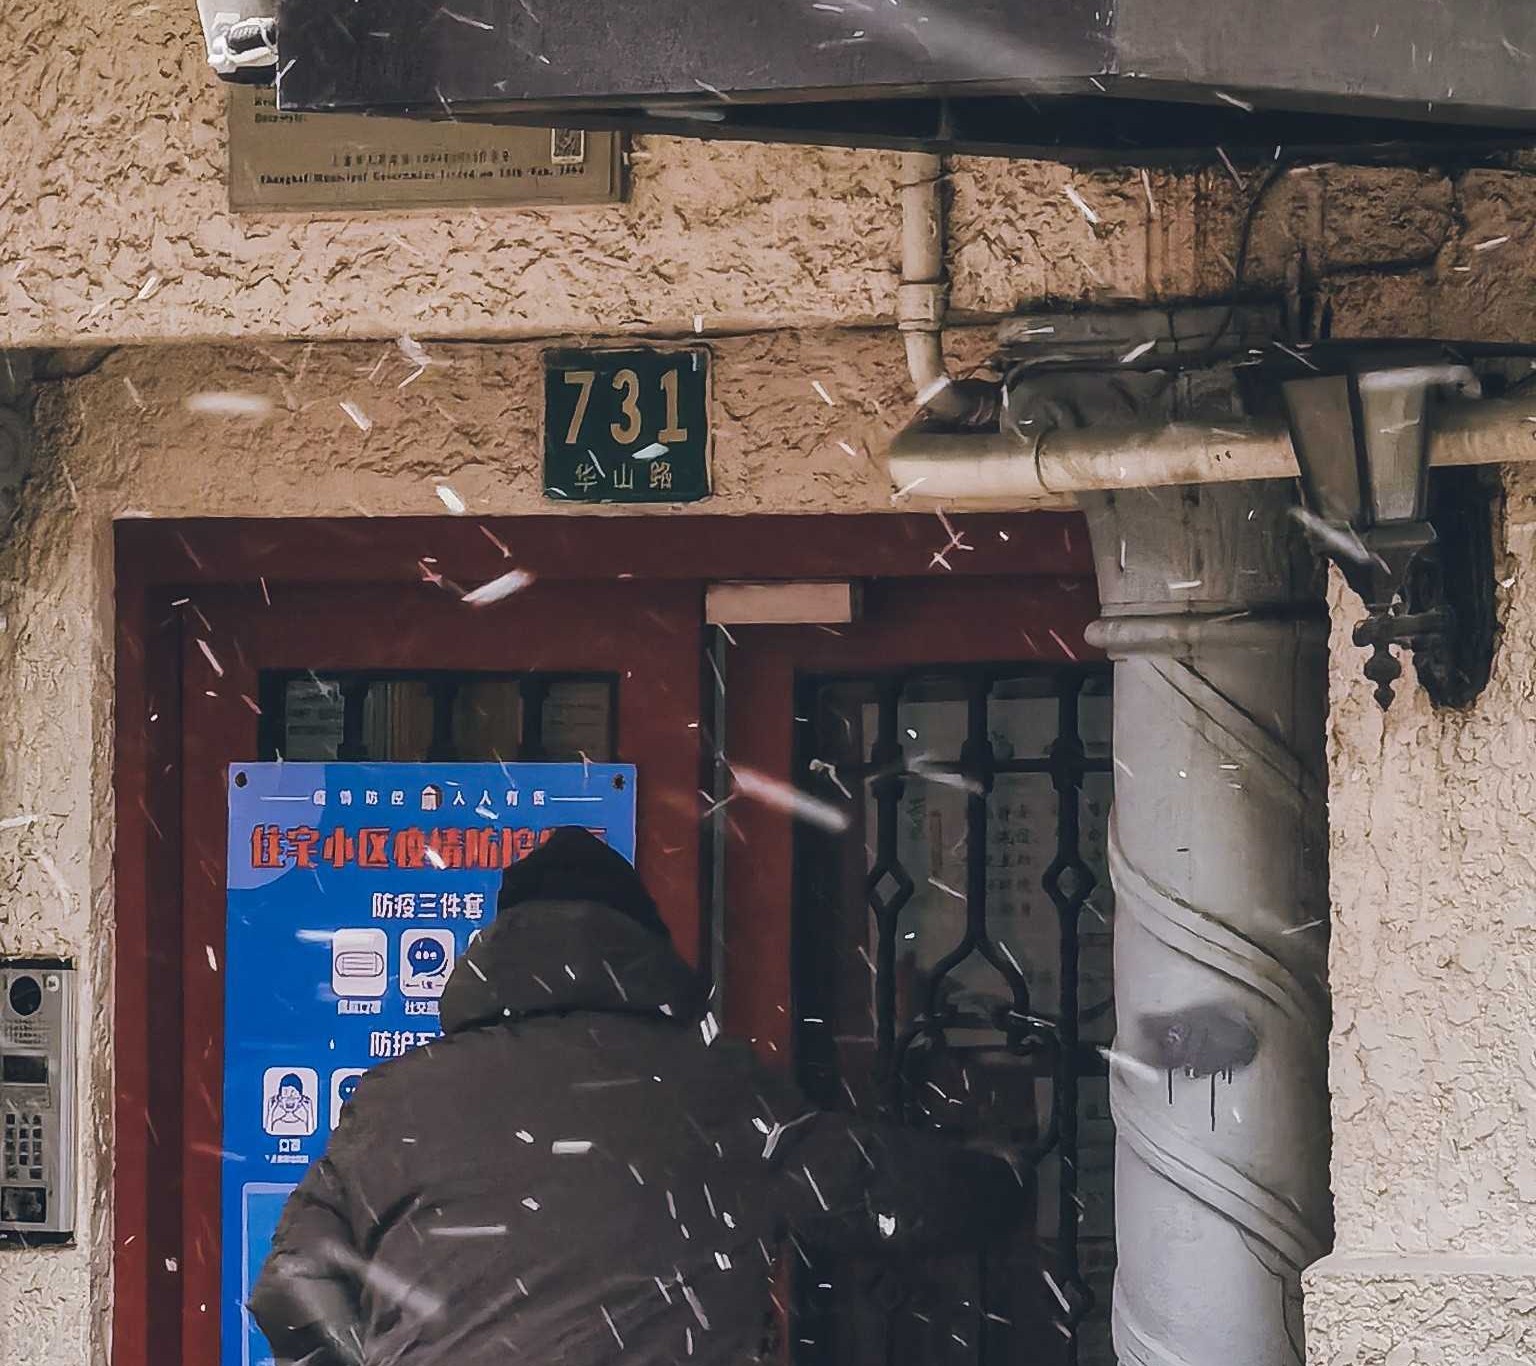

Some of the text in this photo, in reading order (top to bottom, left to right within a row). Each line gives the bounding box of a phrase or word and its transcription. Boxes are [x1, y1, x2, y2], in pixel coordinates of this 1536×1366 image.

[564, 368, 688, 445] 731
[574, 461, 673, 493] 华山路
[251, 823, 608, 869] 住宅小区疫情防控
[372, 892, 485, 919] 防疫三件套
